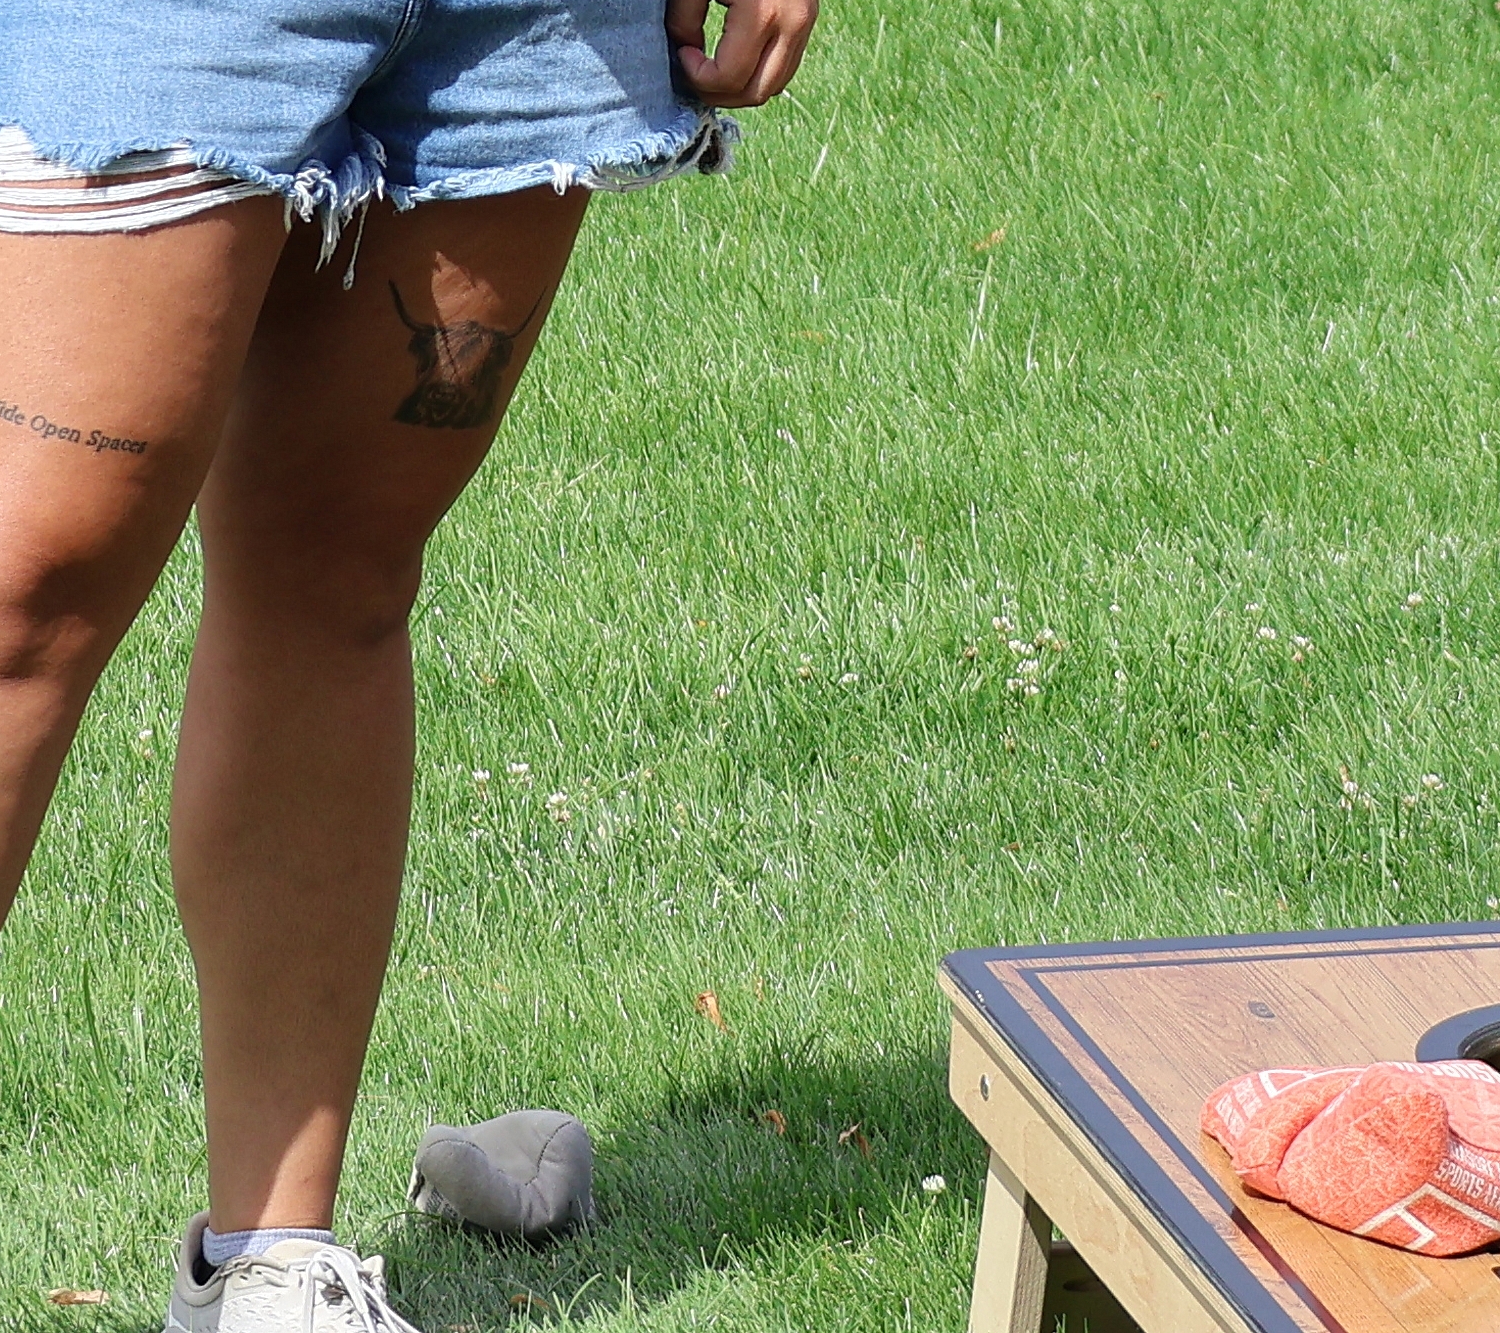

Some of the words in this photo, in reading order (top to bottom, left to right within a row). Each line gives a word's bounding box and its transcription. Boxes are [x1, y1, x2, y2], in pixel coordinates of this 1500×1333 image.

[30, 414, 81, 444] Open
[85, 429, 148, 454] Spaces
[1434, 1158, 1485, 1199] SPORTS
